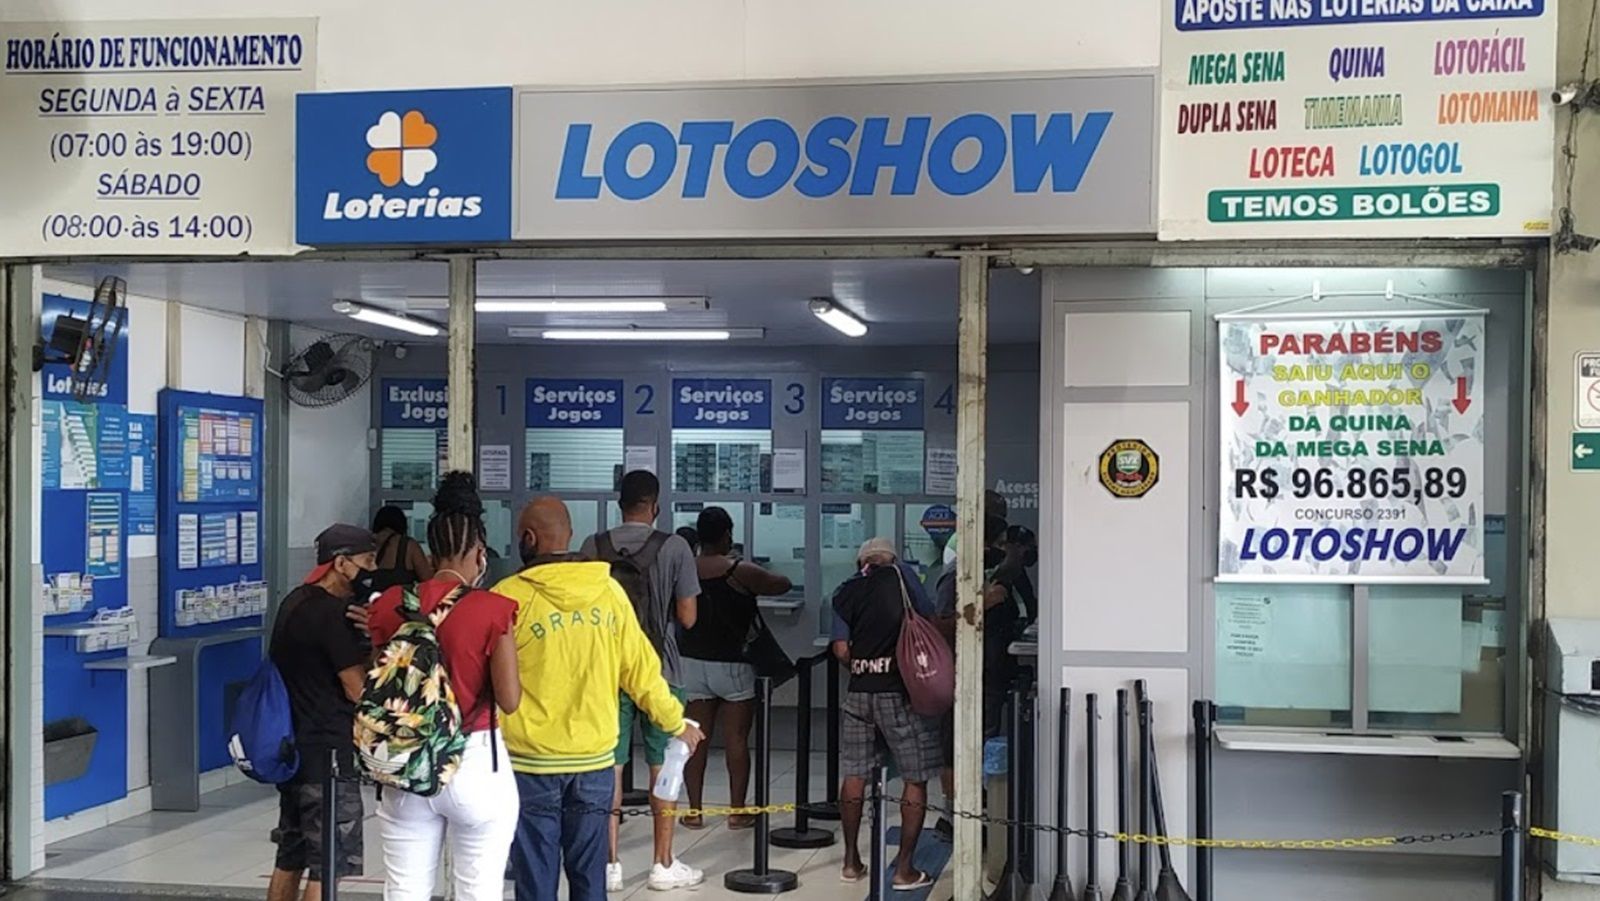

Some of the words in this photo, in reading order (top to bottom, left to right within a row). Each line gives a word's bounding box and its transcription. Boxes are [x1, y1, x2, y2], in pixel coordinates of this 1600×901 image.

[1181, 0, 1263, 24] APOSTE
[1269, 0, 1312, 21] NAS
[1320, 0, 1424, 18] LOTERIAS
[6, 34, 95, 70] HORÁRIO
[99, 37, 125, 68] DE
[129, 34, 303, 67] FUNCIONAMENTO
[1329, 47, 1385, 80] QUINA
[1434, 29, 1526, 75] LOTOFÁCIL
[1189, 53, 1237, 85] MEGA
[1242, 51, 1285, 82] SENA
[39, 88, 158, 113] SEGUNDA
[165, 89, 179, 112] à
[188, 86, 265, 111] SEXTA
[1305, 95, 1403, 130] TIMEMANIA
[1438, 91, 1539, 125] LOTOMANIA
[1178, 103, 1233, 135] DUPLA
[1237, 100, 1277, 131] SENA
[50, 132, 126, 162] (07:00
[135, 132, 162, 157] às
[171, 131, 252, 161] 19:00)
[555, 112, 1114, 201] LOTOSHOW
[1249, 146, 1335, 179] LOTECA
[1359, 142, 1463, 176] LOTOGOL
[97, 168, 201, 196] SÁBADO
[323, 188, 482, 220] Loterias
[1222, 195, 1339, 218] TEMOS
[1353, 187, 1490, 215] BOLÕES
[131, 213, 159, 240] às
[169, 213, 252, 243] 14:00)
[1260, 327, 1443, 355] PARABÉNS
[1272, 363, 1333, 382] SAIU
[1339, 362, 1403, 381] AQUI
[1411, 362, 1430, 380] O
[389, 385, 448, 402] Exclusi
[496, 385, 506, 415] 1
[533, 385, 616, 408] Serviços
[634, 384, 655, 415] 2
[680, 385, 764, 408] Serviços
[784, 383, 805, 414] 3
[829, 385, 917, 408] Serviços
[1278, 388, 1423, 407] GANHADOR
[401, 403, 448, 423] Jogo
[548, 407, 601, 423] Jogos
[694, 407, 749, 424] Jogos
[845, 407, 901, 423] Jogos
[1289, 415, 1321, 432] DA
[1329, 415, 1412, 432] QUINA
[1255, 440, 1288, 457] DA
[1296, 440, 1369, 457] MEGA
[1377, 439, 1445, 456] SENA
[994, 479, 1039, 494] Acess
[1235, 467, 1279, 502] R$
[1292, 467, 1467, 505] 96.865,89
[1295, 508, 1373, 521] CONCURSO
[1377, 507, 1406, 520] 2391
[1239, 528, 1467, 561] LOTOSHOW
